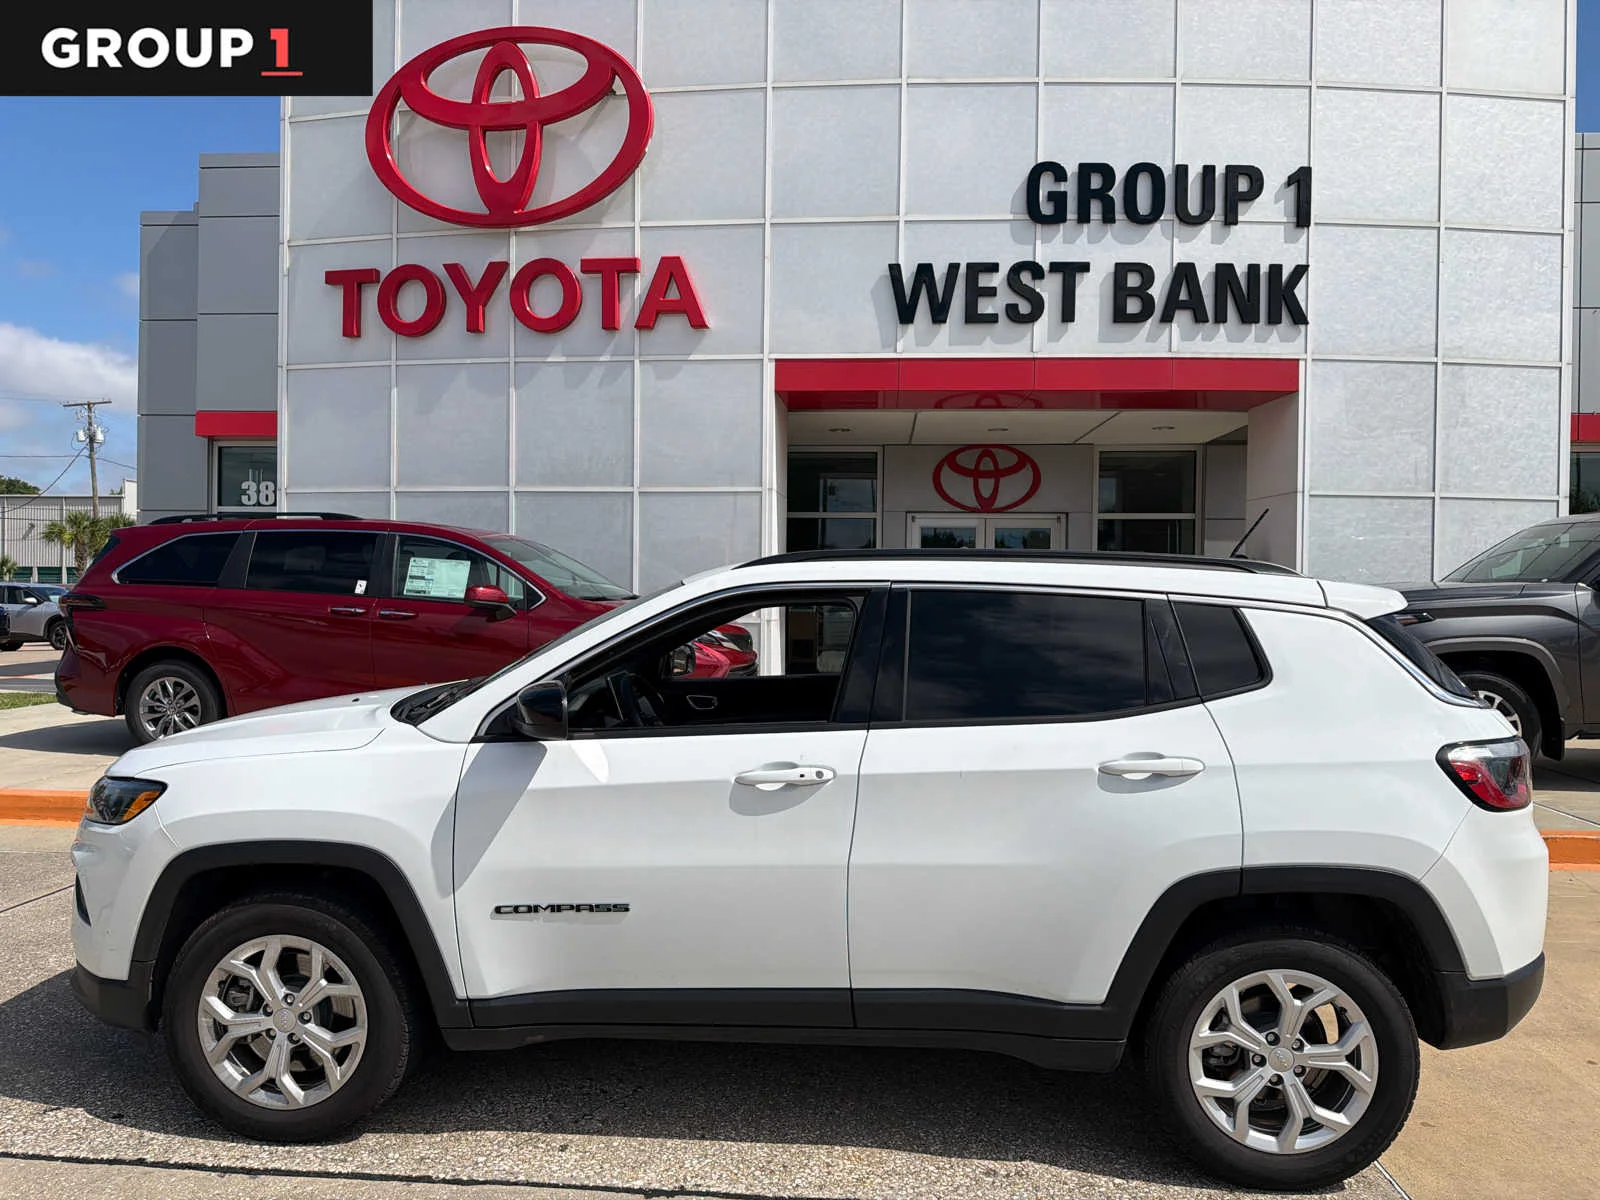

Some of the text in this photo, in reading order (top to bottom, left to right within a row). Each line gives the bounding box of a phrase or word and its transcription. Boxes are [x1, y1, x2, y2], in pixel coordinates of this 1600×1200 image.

[1026, 161, 1312, 228] GROUP 1
[325, 255, 710, 339] TOYOTA
[888, 260, 1310, 325] WEST BANK
[241, 480, 275, 506] 38
[494, 903, 631, 914] COMPASS
